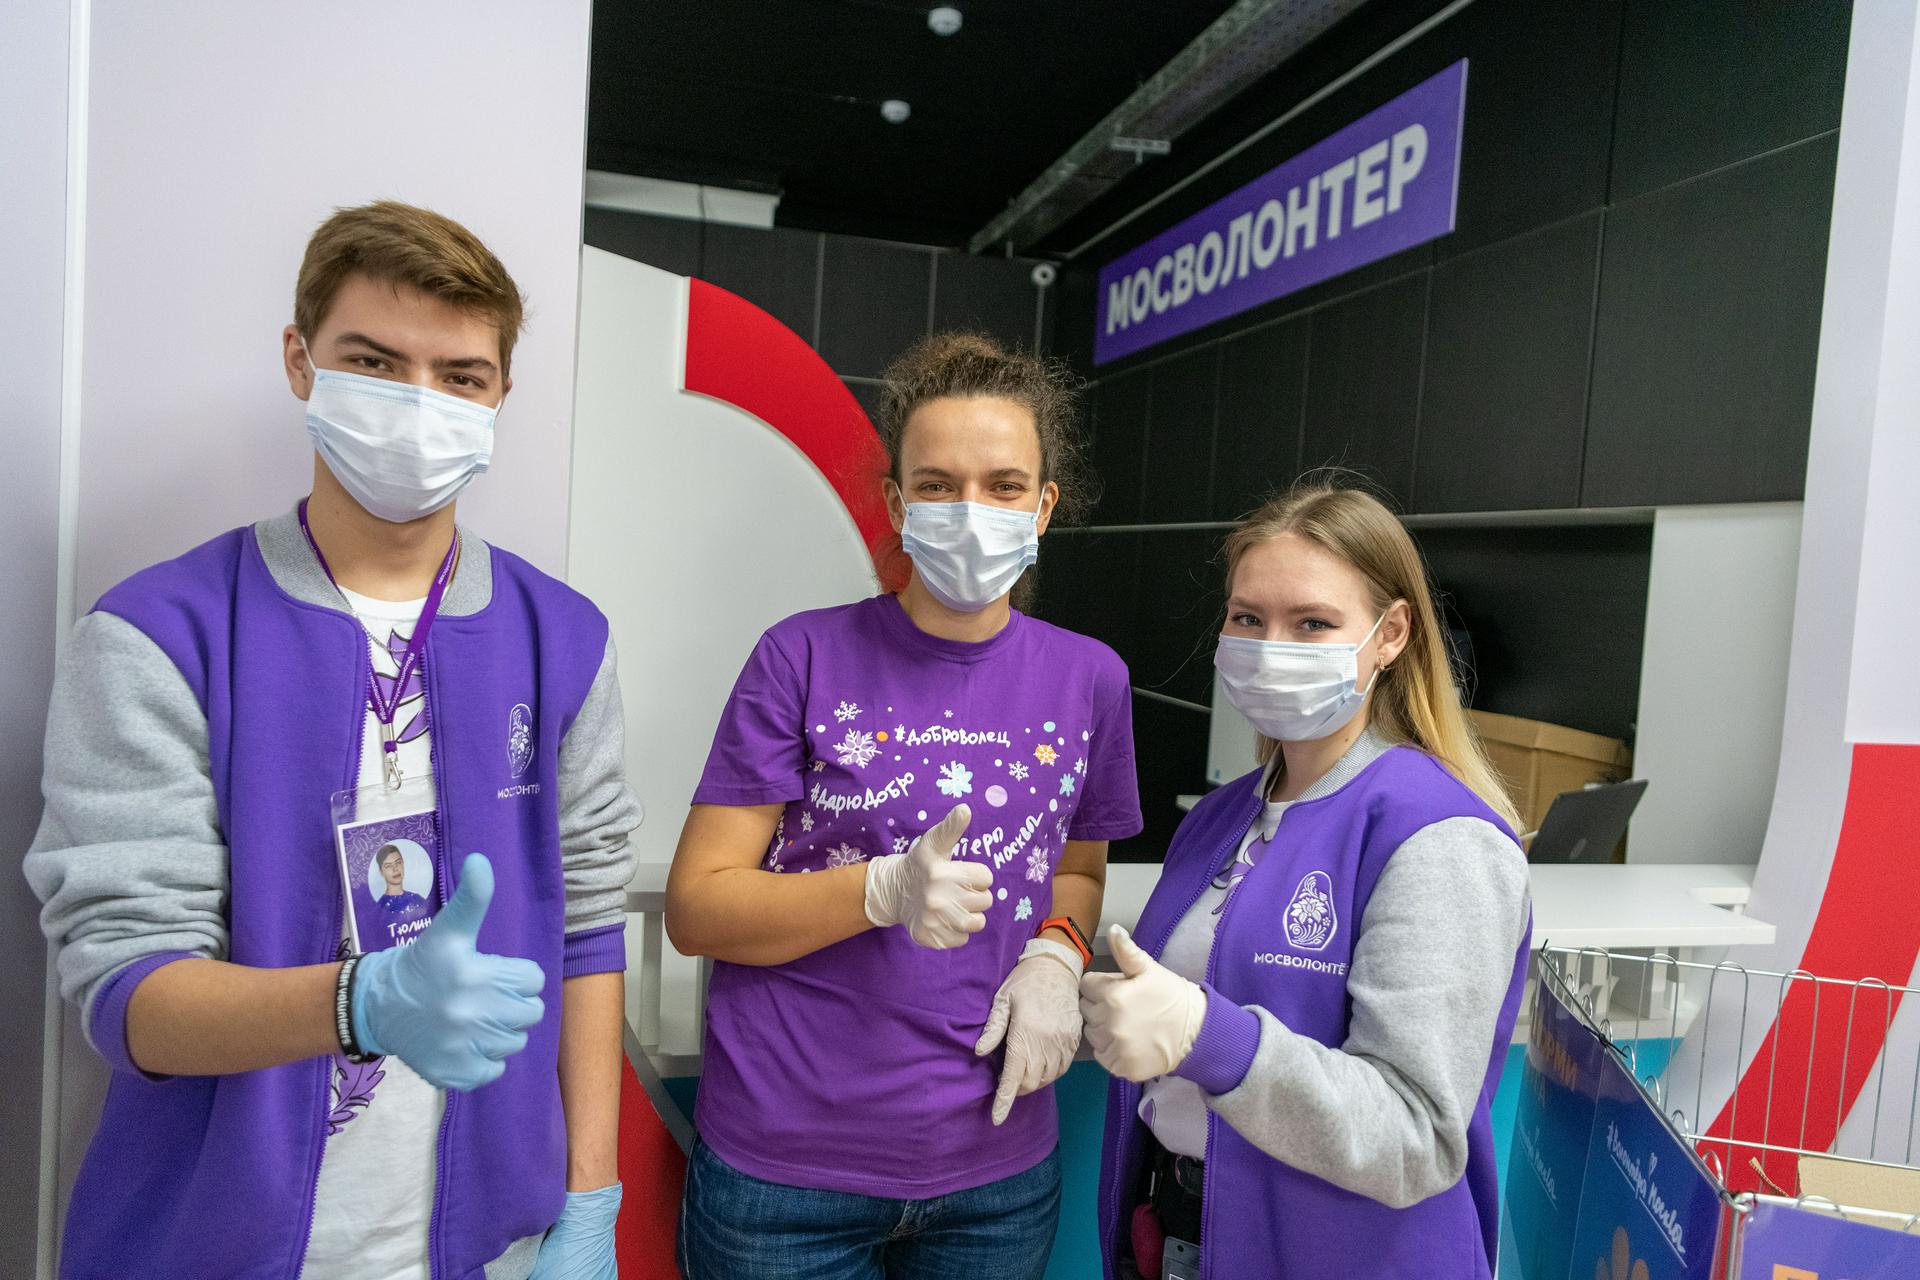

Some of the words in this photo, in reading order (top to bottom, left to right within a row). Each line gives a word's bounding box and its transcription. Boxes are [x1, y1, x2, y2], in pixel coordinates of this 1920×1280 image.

[1106, 123, 1428, 335] МОСВОЛОНТЕР
[1253, 952, 1349, 976] МОСВОЛОНТЁ
[336, 987, 352, 1046] volunteers
